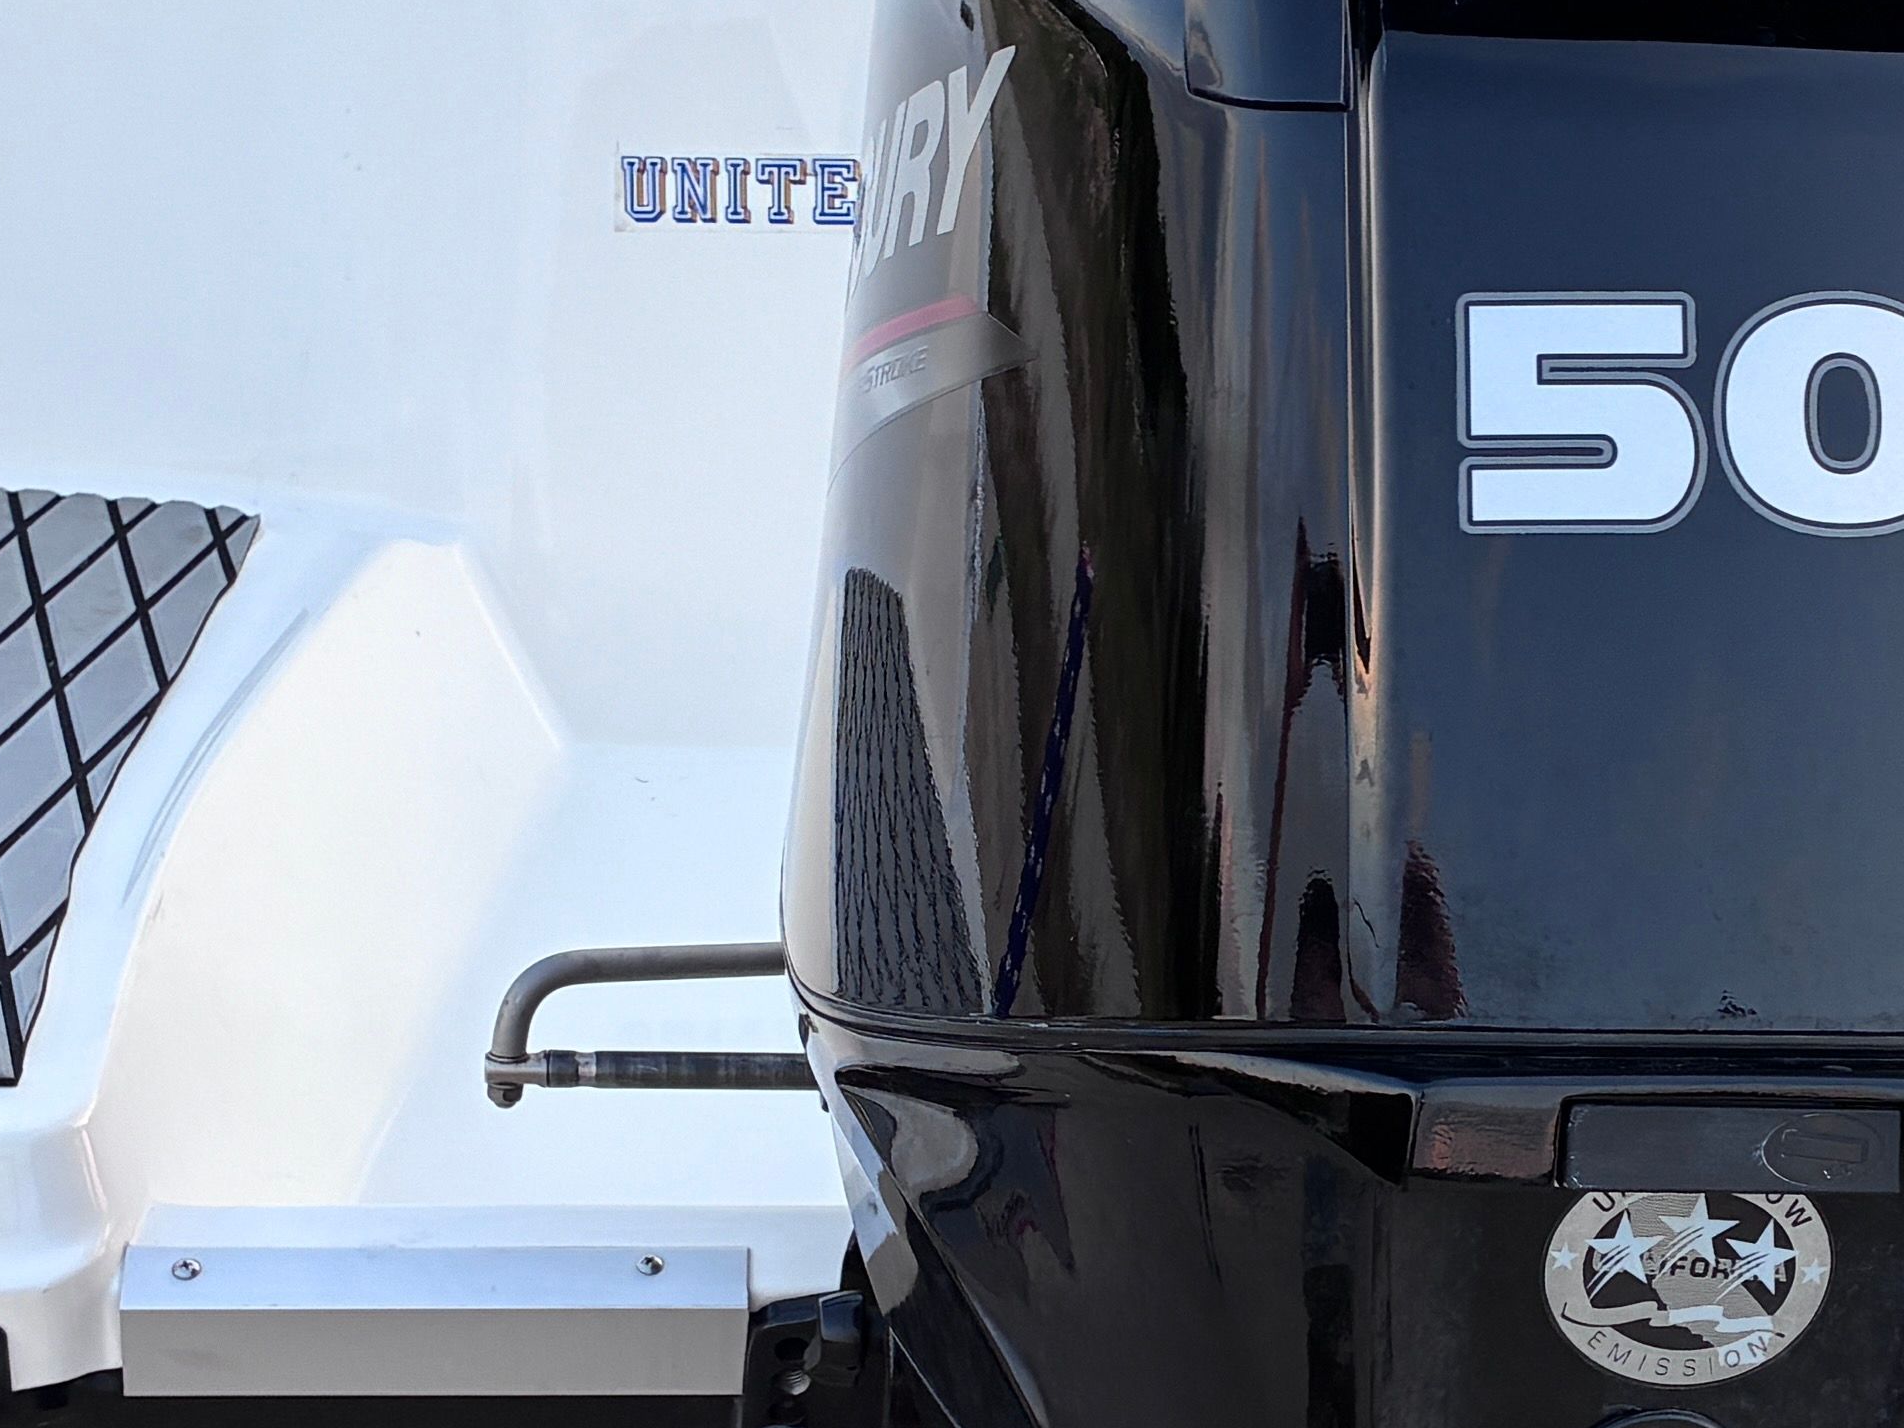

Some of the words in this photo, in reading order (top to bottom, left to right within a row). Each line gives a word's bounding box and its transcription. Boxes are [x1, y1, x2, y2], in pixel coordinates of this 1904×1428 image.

[621, 155, 862, 225] UNITE
[850, 45, 1016, 296] URY
[1588, 1330, 1768, 1377] EMISSION
